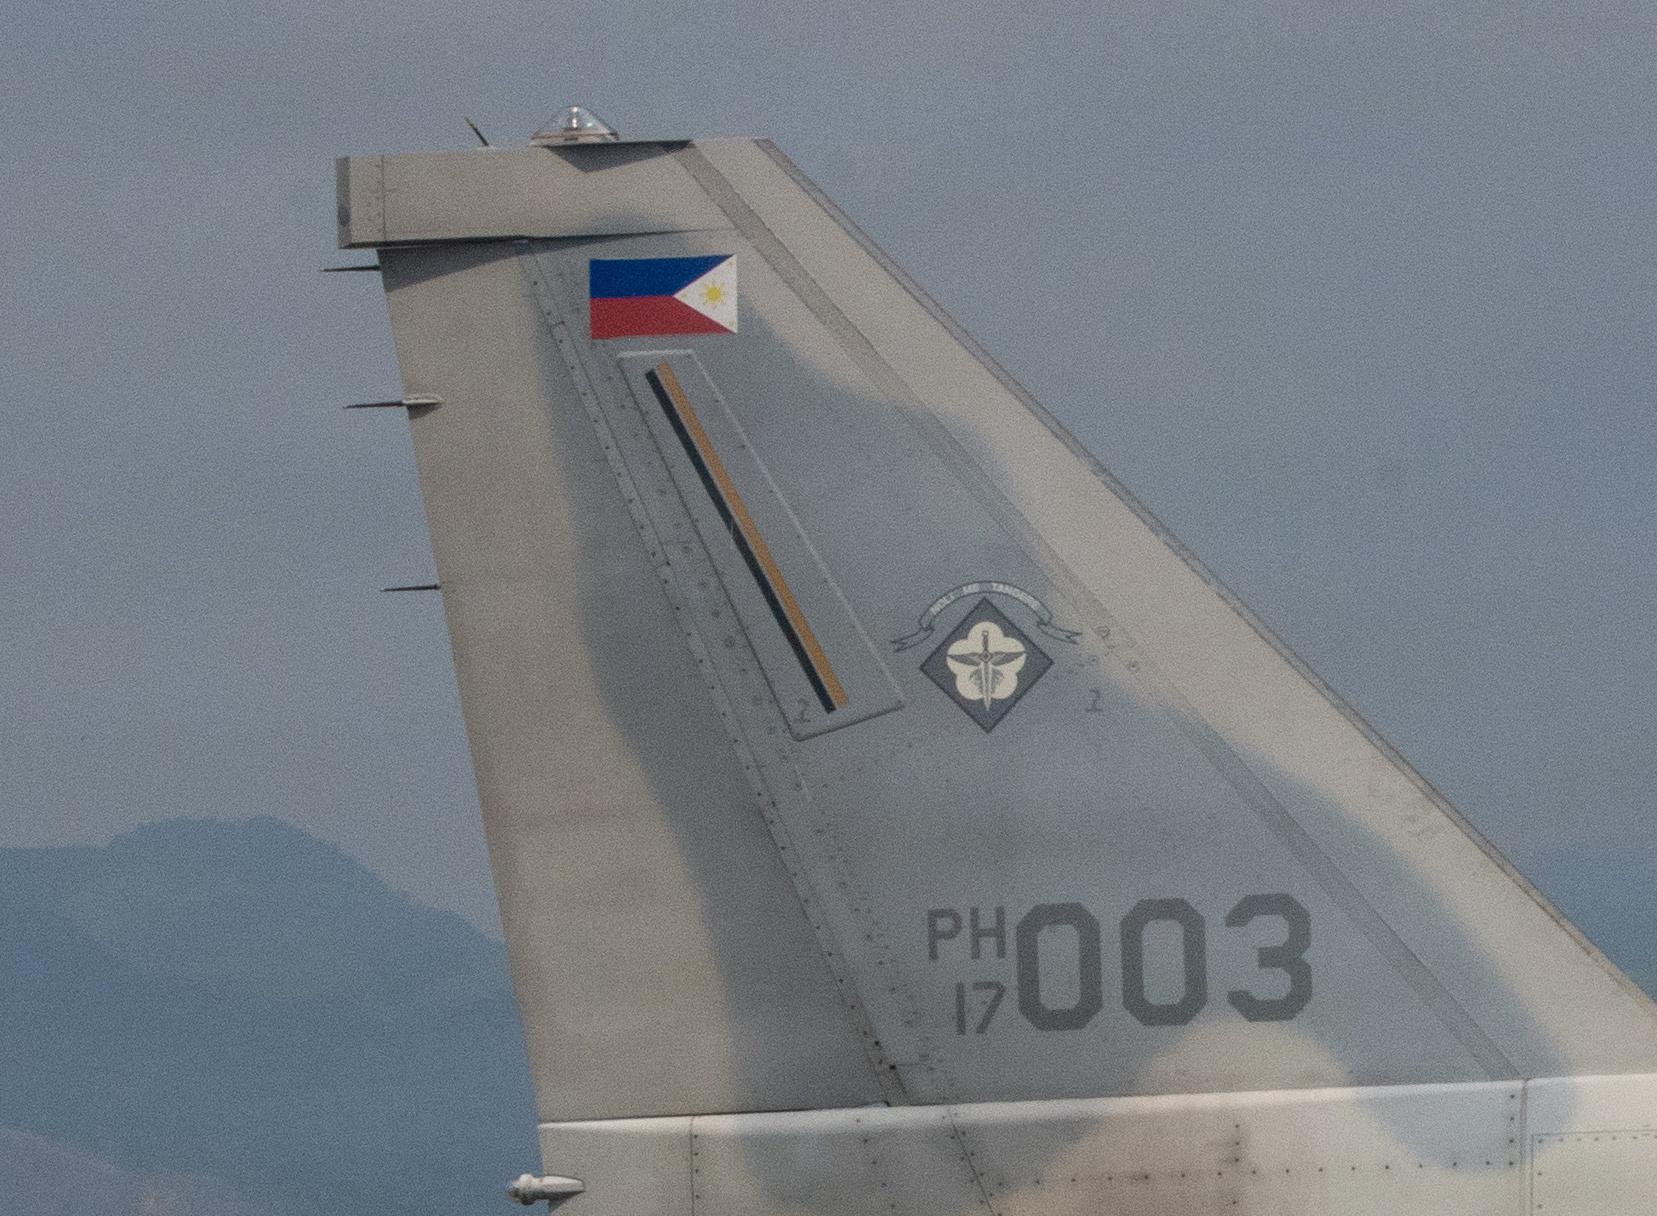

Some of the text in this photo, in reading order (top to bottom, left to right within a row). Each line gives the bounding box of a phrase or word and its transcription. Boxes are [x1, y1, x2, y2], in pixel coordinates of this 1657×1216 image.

[927, 906, 1006, 960] PH
[1016, 893, 1313, 1031] 003
[955, 980, 1006, 1036] 17
